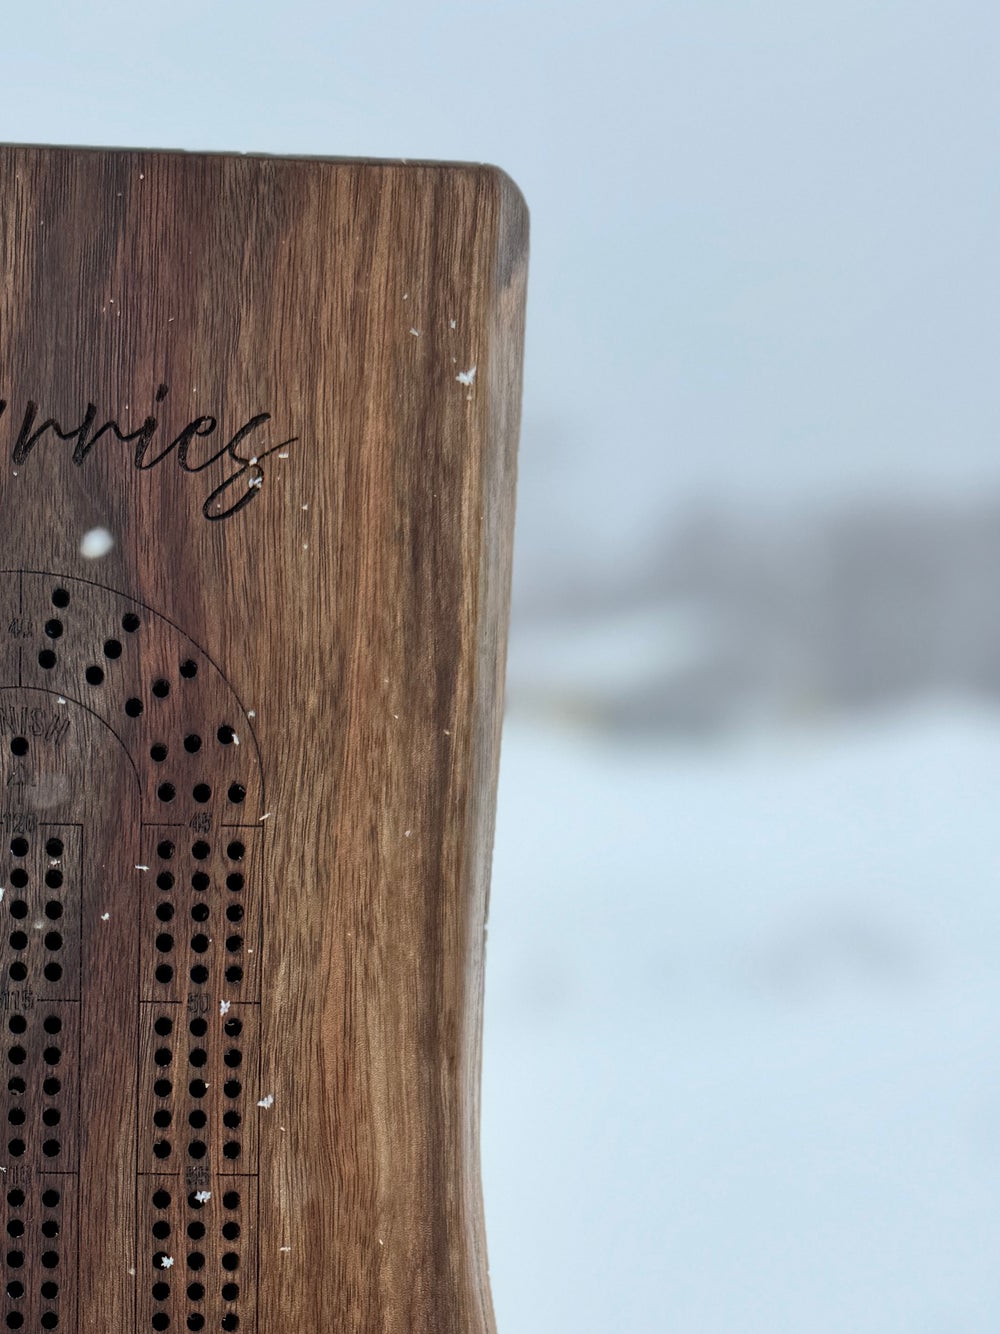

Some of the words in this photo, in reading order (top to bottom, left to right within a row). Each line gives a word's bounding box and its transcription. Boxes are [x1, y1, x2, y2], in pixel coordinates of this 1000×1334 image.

[3, 813, 38, 833] 120
[189, 812, 212, 833] 45
[187, 992, 211, 1013] 50
